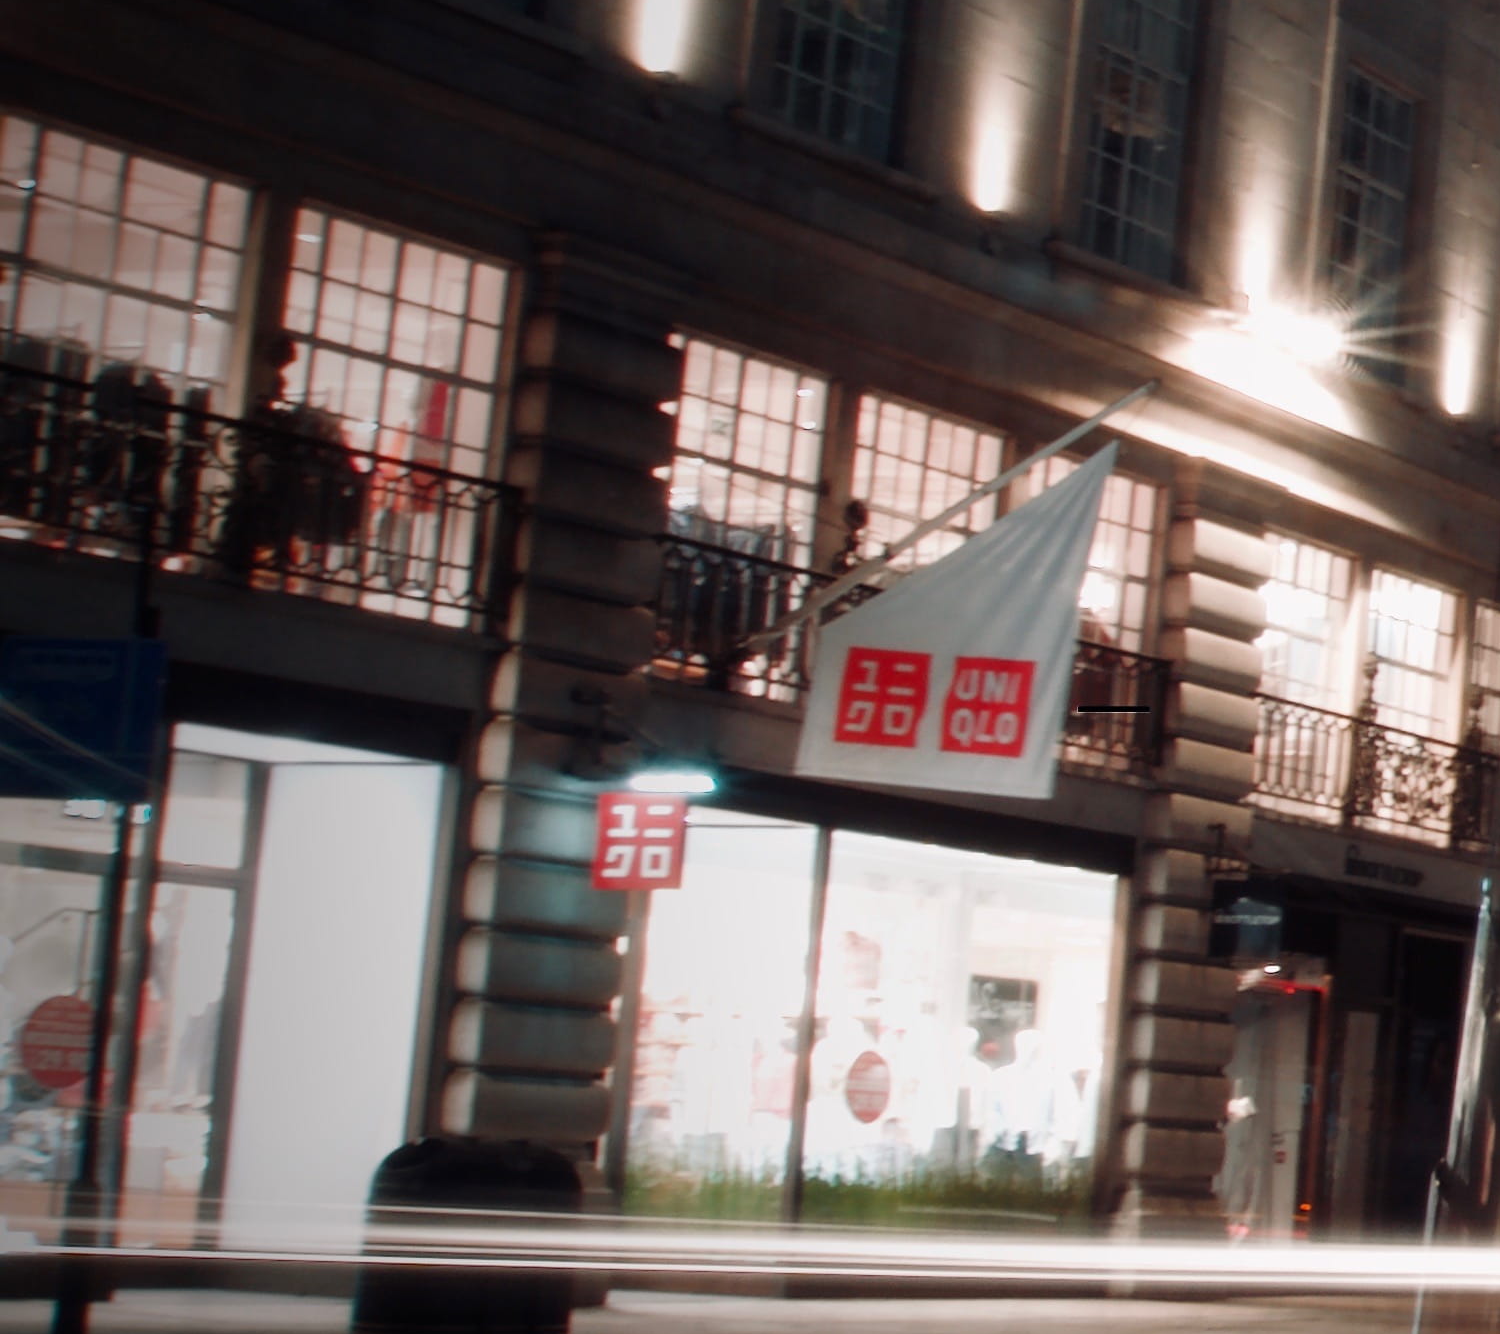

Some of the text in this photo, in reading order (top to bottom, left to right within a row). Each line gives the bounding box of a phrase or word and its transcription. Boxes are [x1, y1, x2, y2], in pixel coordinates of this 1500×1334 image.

[851, 659, 916, 696] ユニ
[955, 668, 1020, 704] UNI
[843, 700, 913, 737] クロ
[949, 708, 1017, 748] QLO
[606, 803, 674, 838] ユニ
[600, 844, 672, 879] クロ
